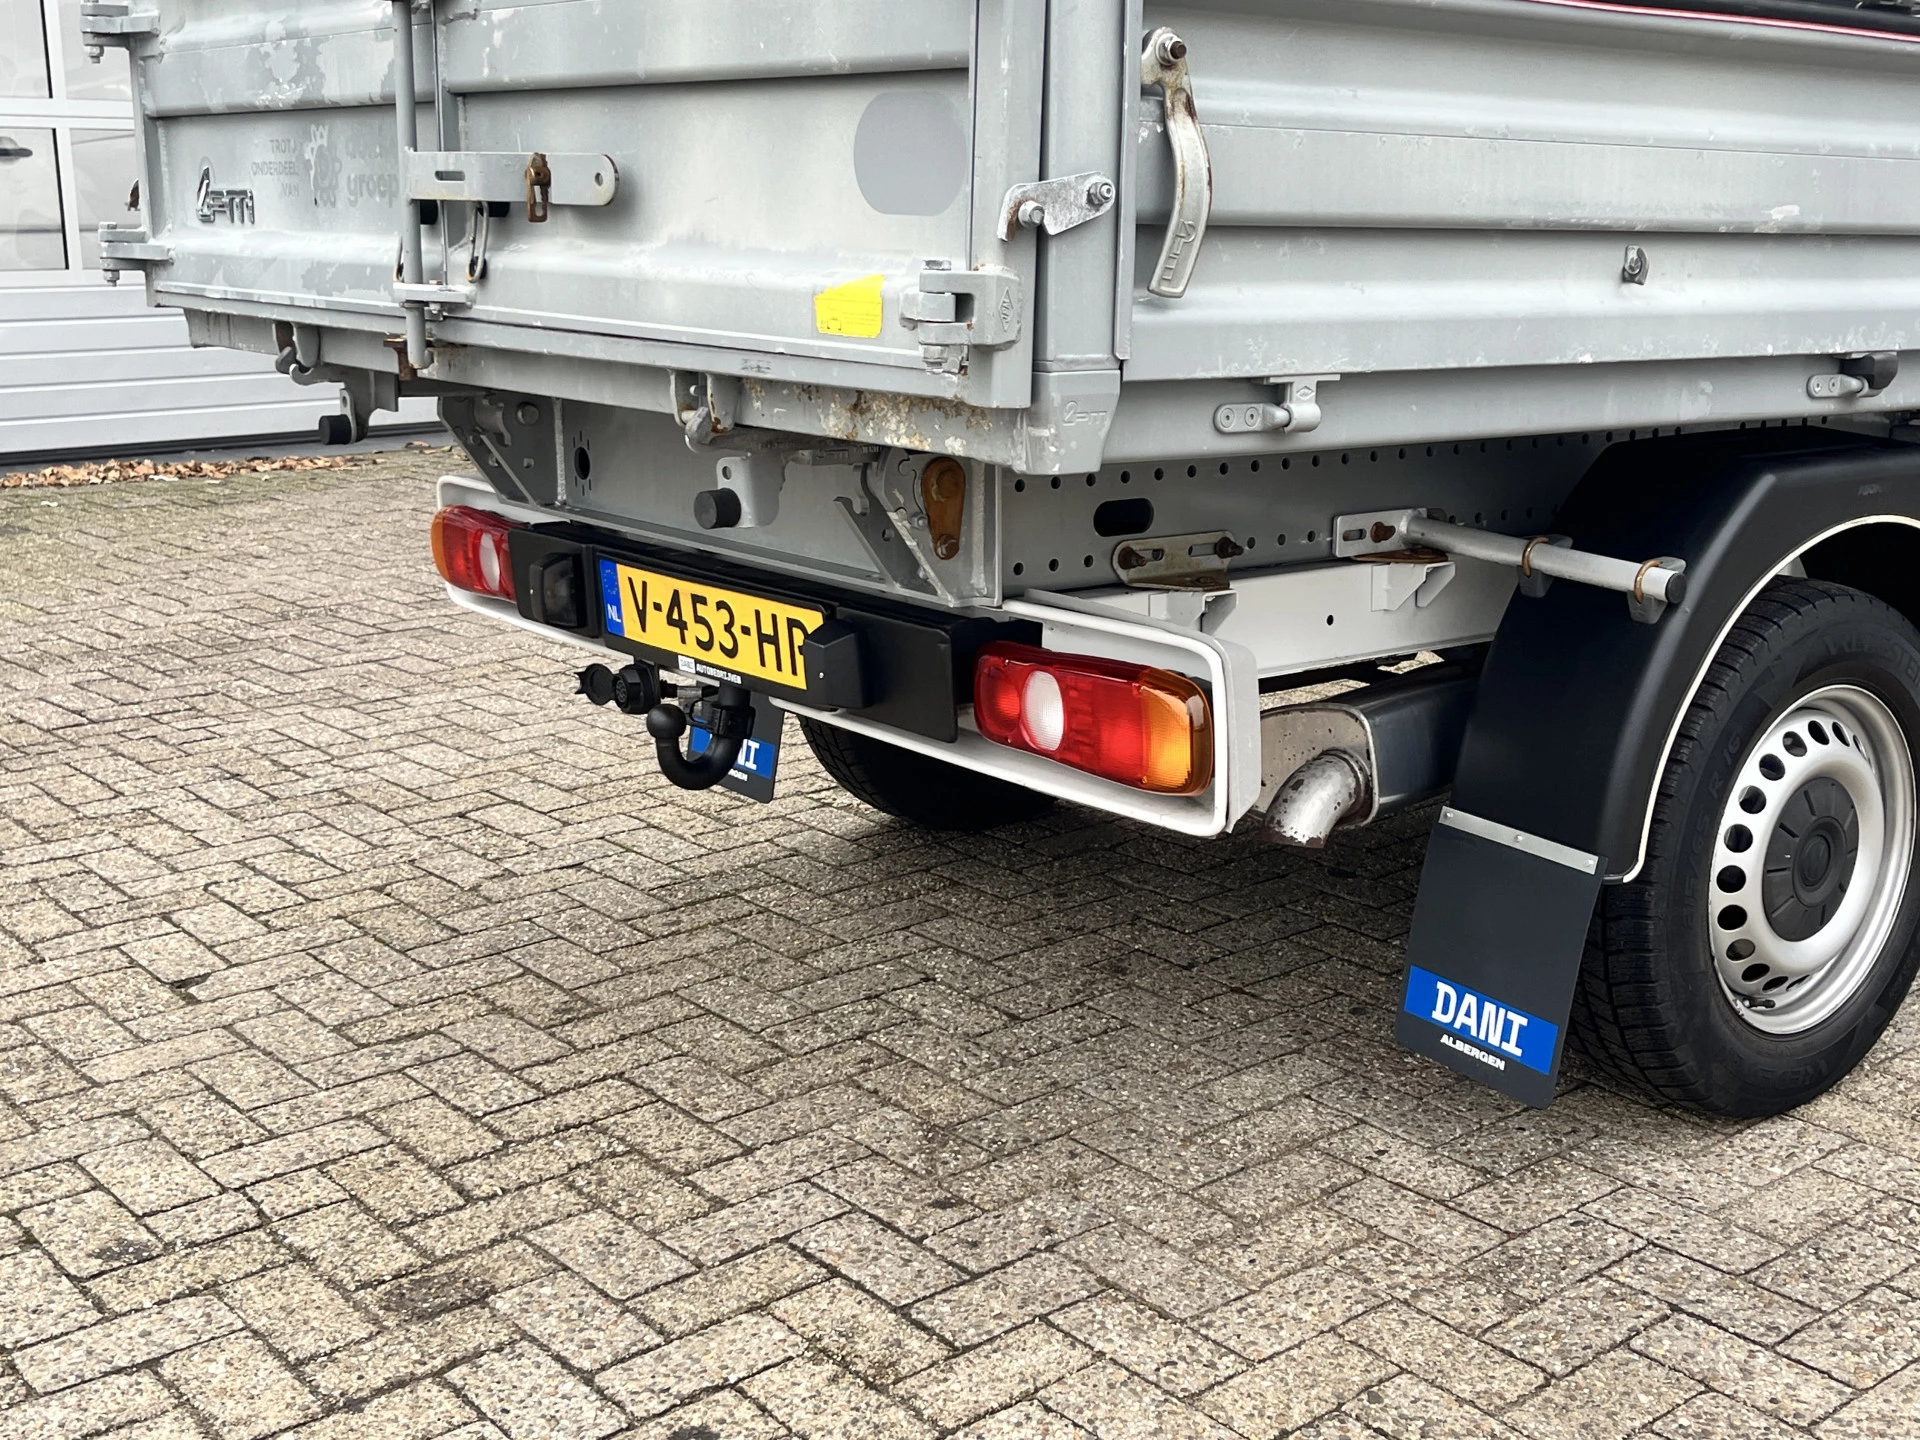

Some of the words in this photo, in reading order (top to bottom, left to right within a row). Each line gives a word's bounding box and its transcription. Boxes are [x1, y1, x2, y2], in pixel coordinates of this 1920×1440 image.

[607, 603, 622, 623] NL
[1431, 980, 1529, 1057] DANI
[1439, 1033, 1506, 1071] ALBERGEN
